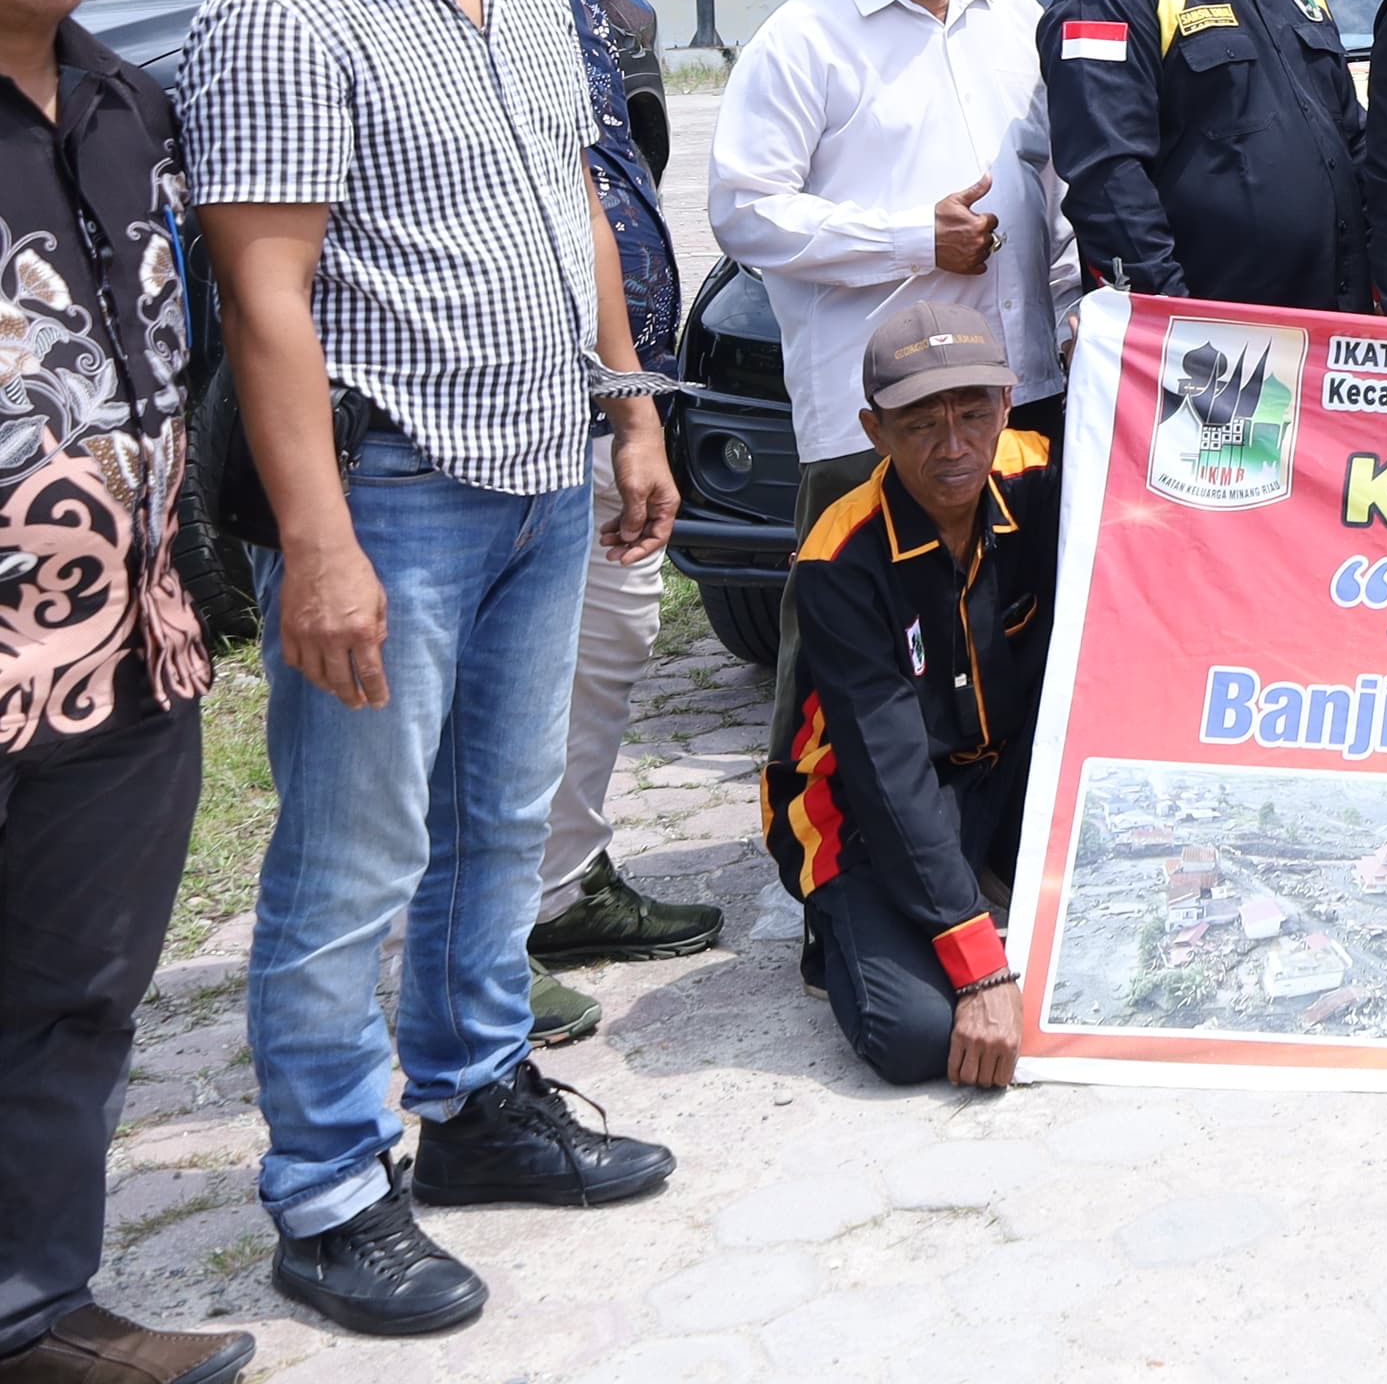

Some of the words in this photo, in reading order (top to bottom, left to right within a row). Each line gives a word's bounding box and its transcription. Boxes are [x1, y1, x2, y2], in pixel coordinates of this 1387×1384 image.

[1158, 472, 1185, 494] IKATAN
[1186, 485, 1228, 501] KELUARGA
[1229, 487, 1261, 501] MINANG
[1261, 479, 1281, 496] RIAU
[1200, 465, 1246, 487] IKMR
